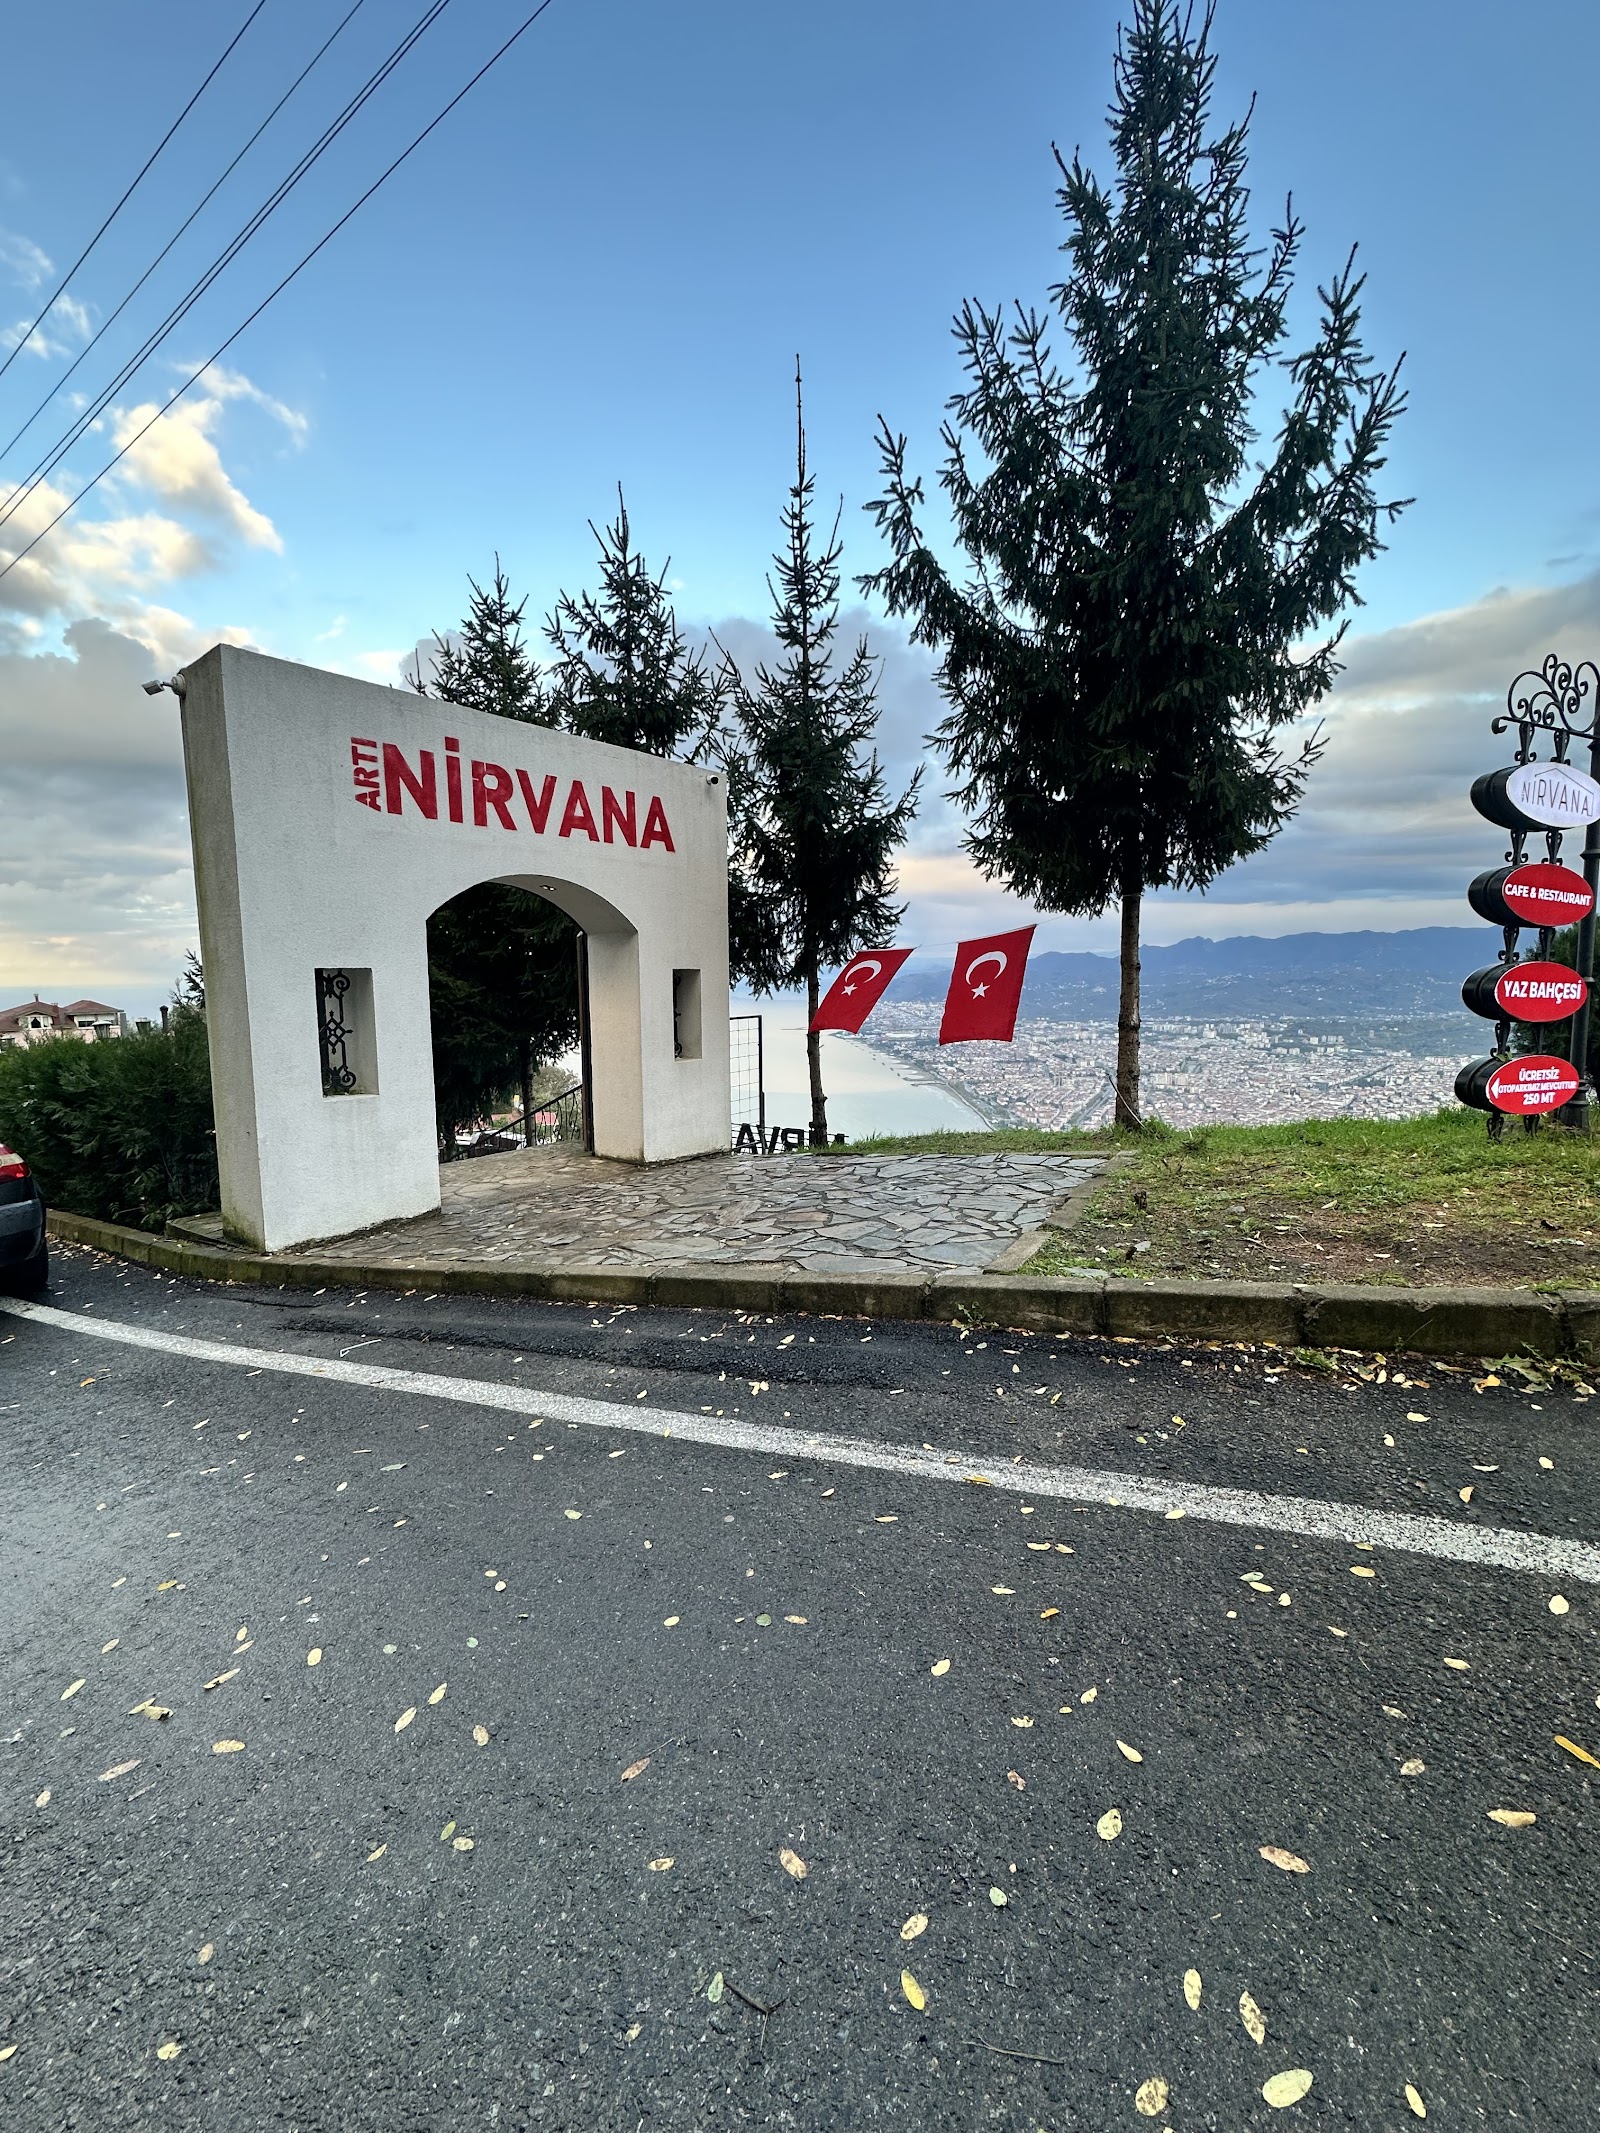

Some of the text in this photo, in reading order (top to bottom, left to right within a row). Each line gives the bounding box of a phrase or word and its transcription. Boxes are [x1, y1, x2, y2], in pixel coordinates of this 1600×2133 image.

[351, 736, 382, 812] ARTI
[382, 736, 676, 853] NİRVANA
[1522, 779, 1590, 816] NIRVANA
[1505, 883, 1592, 906] CAFE & RESTAURANT
[1504, 980, 1582, 1004] YAZ BAHÇESİ
[1519, 1066, 1560, 1082] ÜCRETSİZ
[1523, 1092, 1556, 1105] 250 MT
